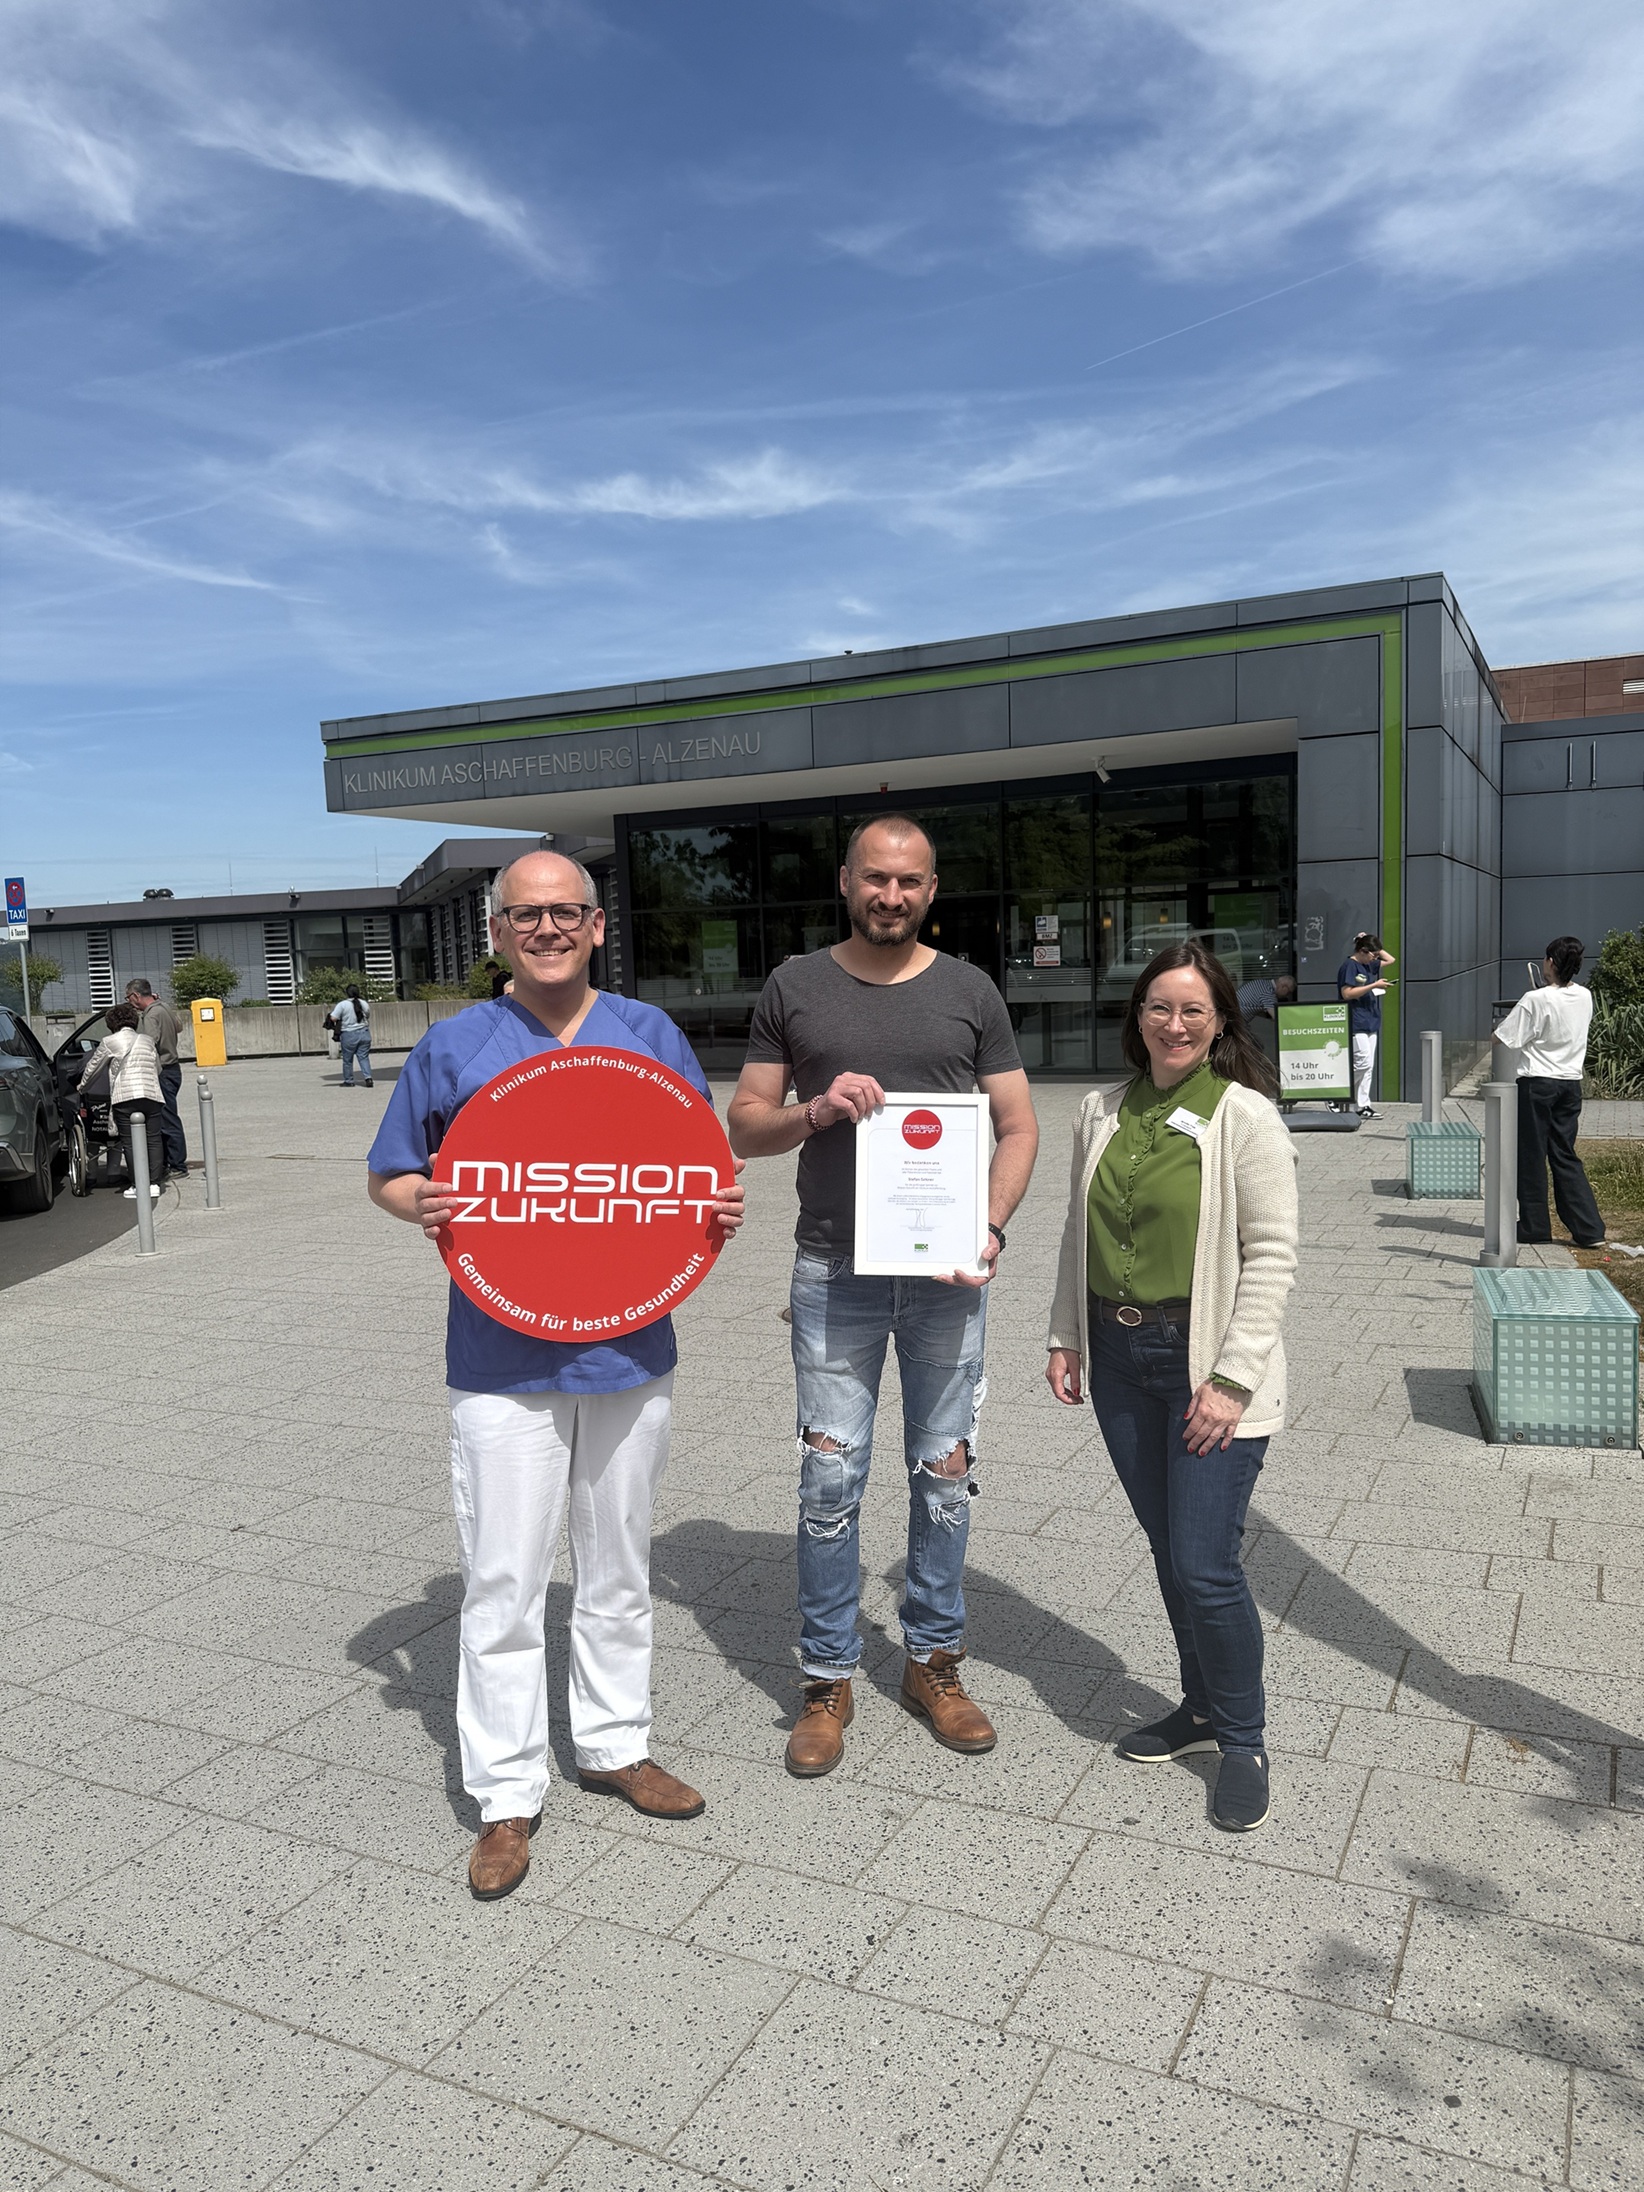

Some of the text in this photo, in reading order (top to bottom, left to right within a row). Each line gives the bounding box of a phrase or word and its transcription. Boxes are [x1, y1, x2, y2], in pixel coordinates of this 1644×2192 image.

[343, 765, 436, 794] KLINIKUM
[440, 745, 633, 785] ASCHAFFENBURG
[651, 731, 762, 766] ALZENAU
[9, 909, 26, 920] TAXI
[1282, 1027, 1345, 1036] BESUCHSZEITEN
[489, 1055, 694, 1109] Klinikum Aschaffenburg-Alzenau
[452, 1160, 719, 1195] MISSION
[450, 1197, 718, 1224] ZUKUNFT
[457, 1251, 706, 1332] Gemeinsam für beste Gesundheit
